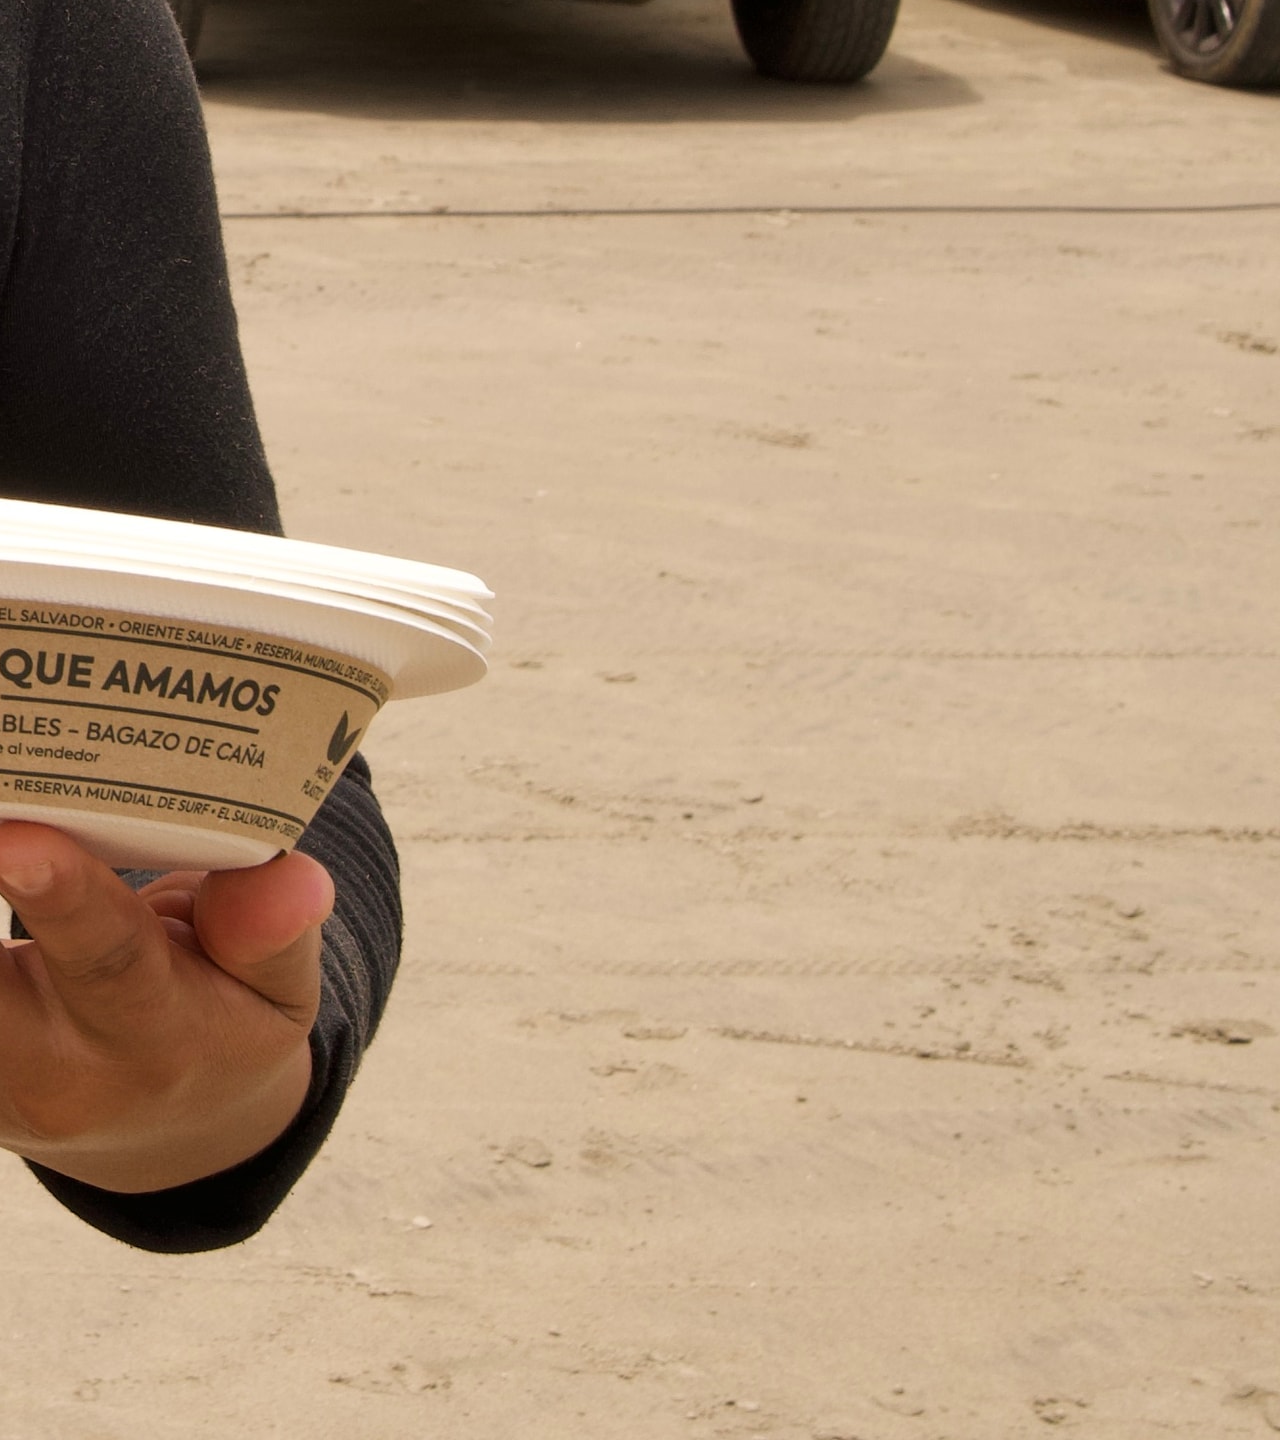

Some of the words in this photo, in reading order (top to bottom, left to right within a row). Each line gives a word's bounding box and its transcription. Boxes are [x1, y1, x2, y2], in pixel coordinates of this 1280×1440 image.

[20, 609, 105, 630] SALVADOR
[119, 620, 185, 641] ORIENTE
[186, 630, 244, 651] SALVAJE
[253, 641, 303, 664] RESERVA
[304, 654, 345, 676] MUNDIAL
[102, 659, 280, 716] AMAMOS
[7, 742, 22, 755] al
[26, 745, 101, 763] vendedor
[86, 721, 180, 751] BAGAZO
[184, 736, 214, 756] DE
[216, 742, 266, 769] CAÑA
[14, 778, 82, 798] RESERVA
[85, 788, 154, 809] MUNDIAL
[156, 797, 177, 810] DE
[177, 799, 208, 815] SURF
[217, 807, 230, 821] EL
[231, 810, 278, 831] SALVADOR
